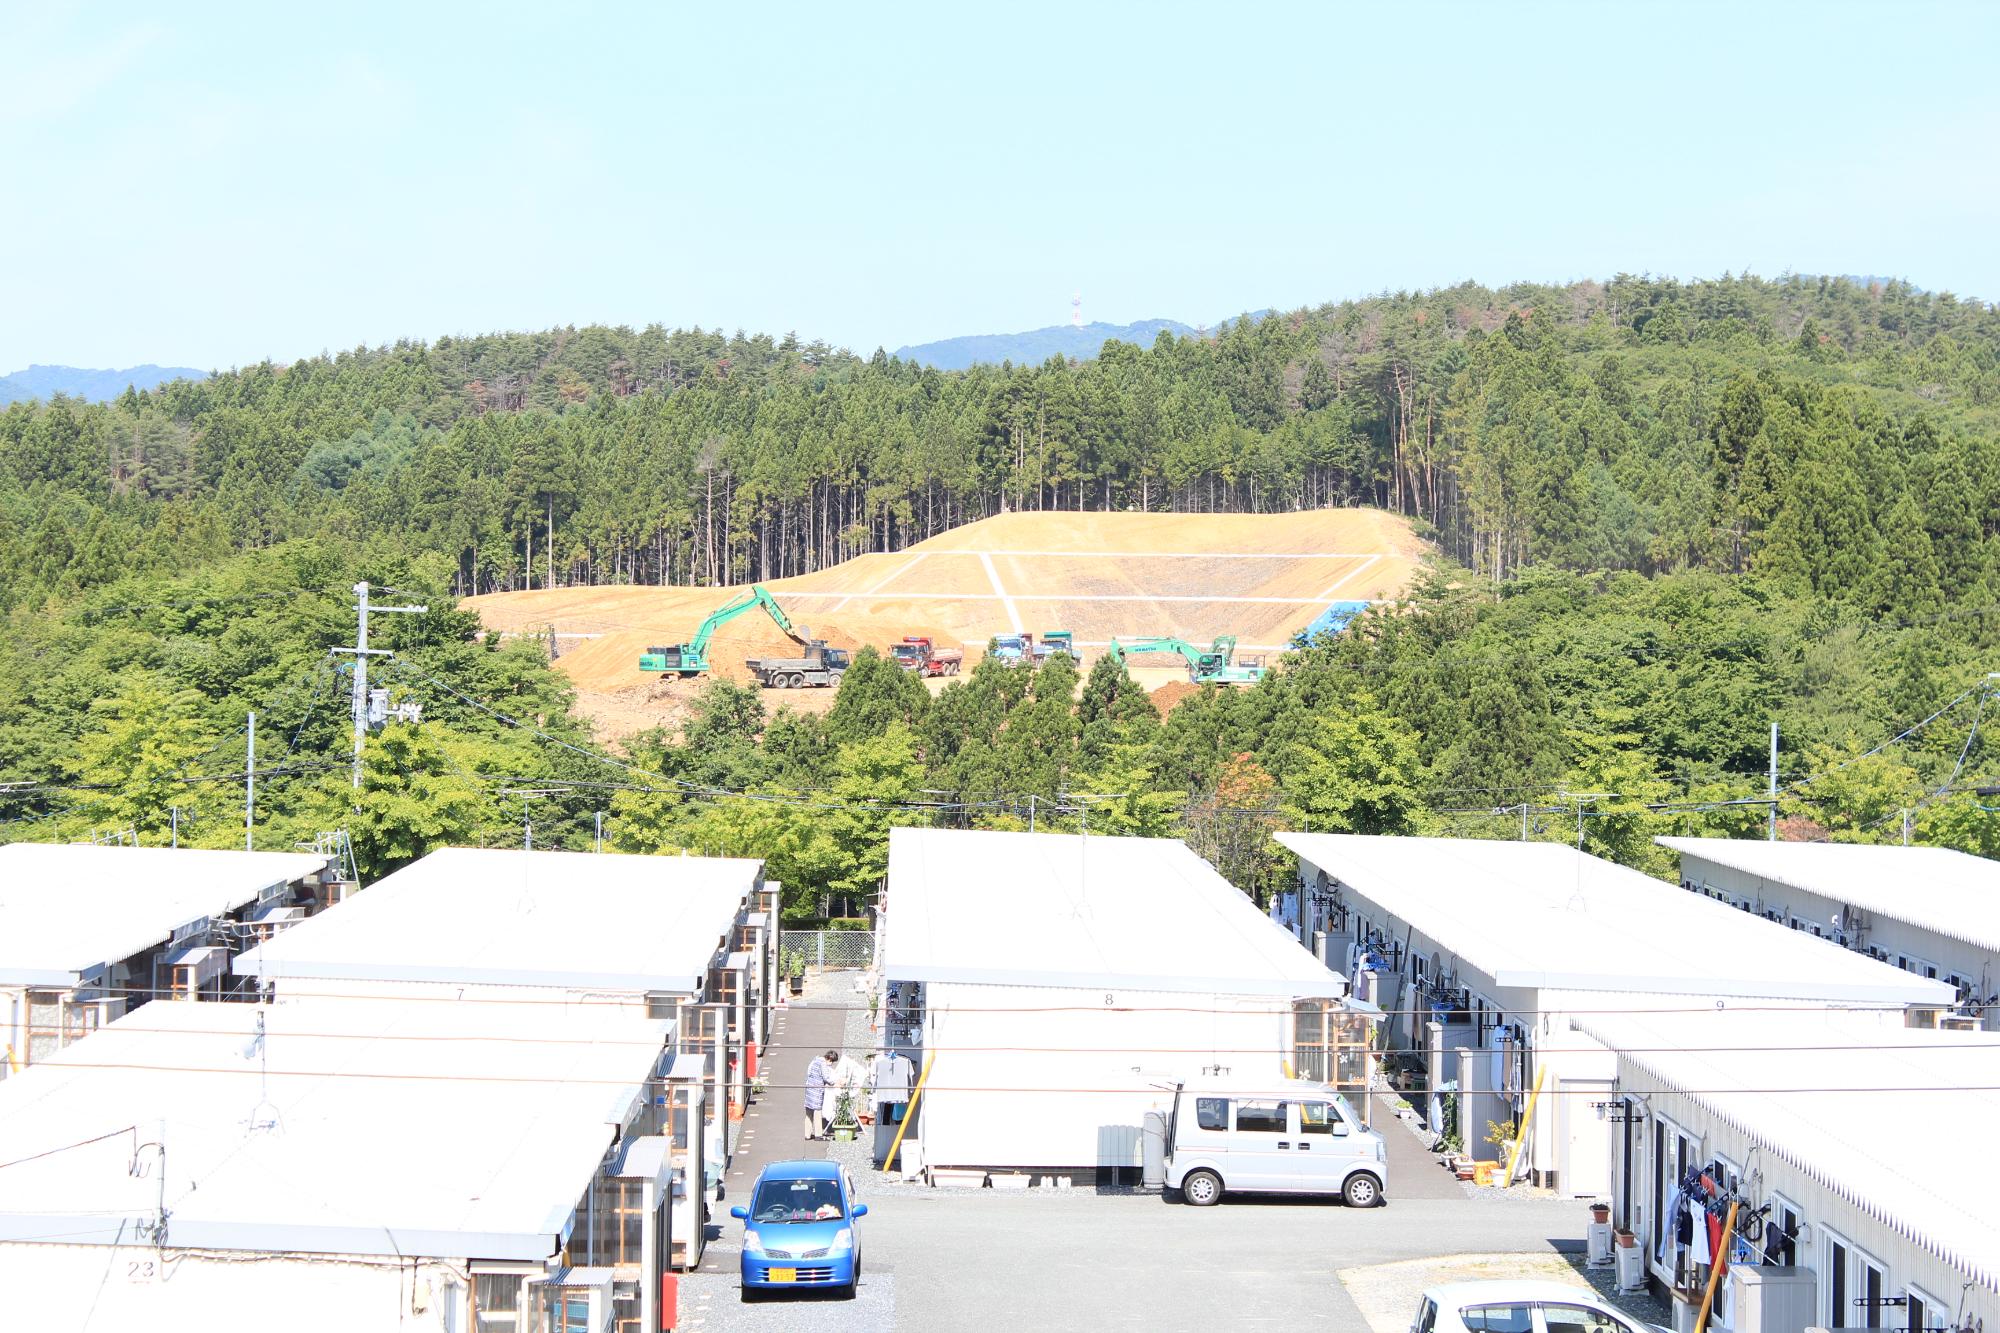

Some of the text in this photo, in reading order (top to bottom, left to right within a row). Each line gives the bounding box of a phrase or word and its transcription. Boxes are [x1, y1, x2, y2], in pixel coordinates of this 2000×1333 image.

[456, 988, 465, 1000] 7
[1105, 993, 1114, 1005] 8
[1716, 1000, 1725, 1011] 9
[128, 1261, 154, 1277] 23
